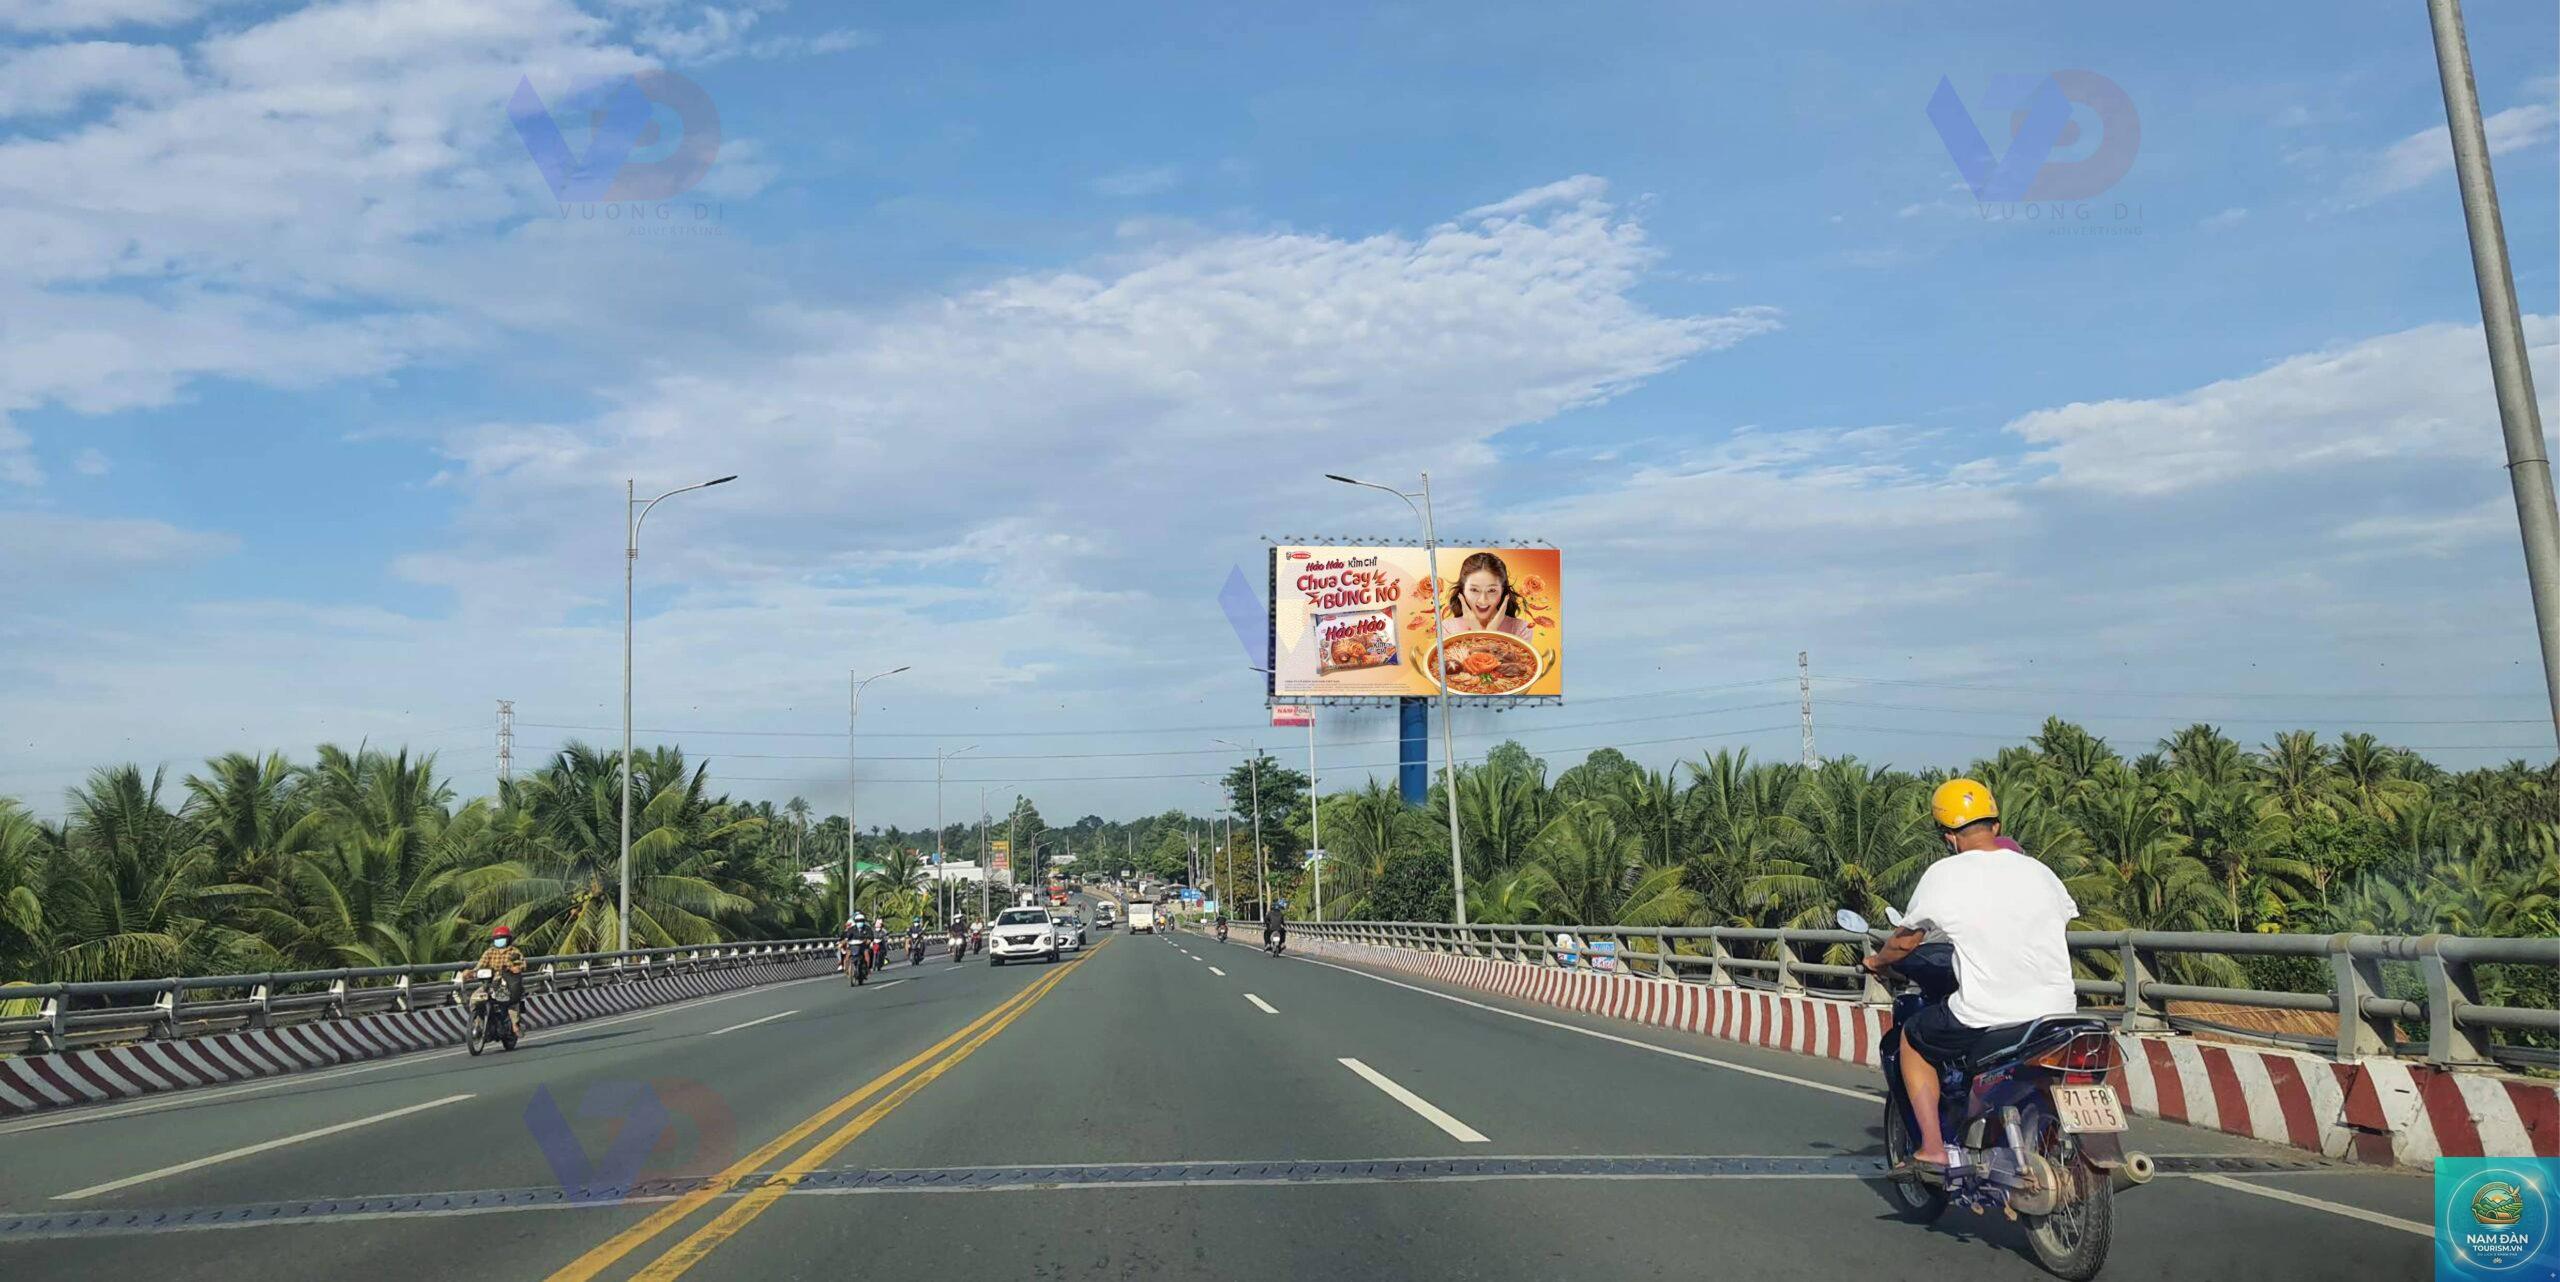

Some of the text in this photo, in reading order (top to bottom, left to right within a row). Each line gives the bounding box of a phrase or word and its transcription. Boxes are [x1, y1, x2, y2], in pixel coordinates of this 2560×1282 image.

[1297, 570, 1371, 591] Chua Cay
[1323, 578, 1400, 609] BÙNG NỔ
[1326, 615, 1386, 641] Hảo Hảo
[2073, 1109, 2116, 1126] 3015
